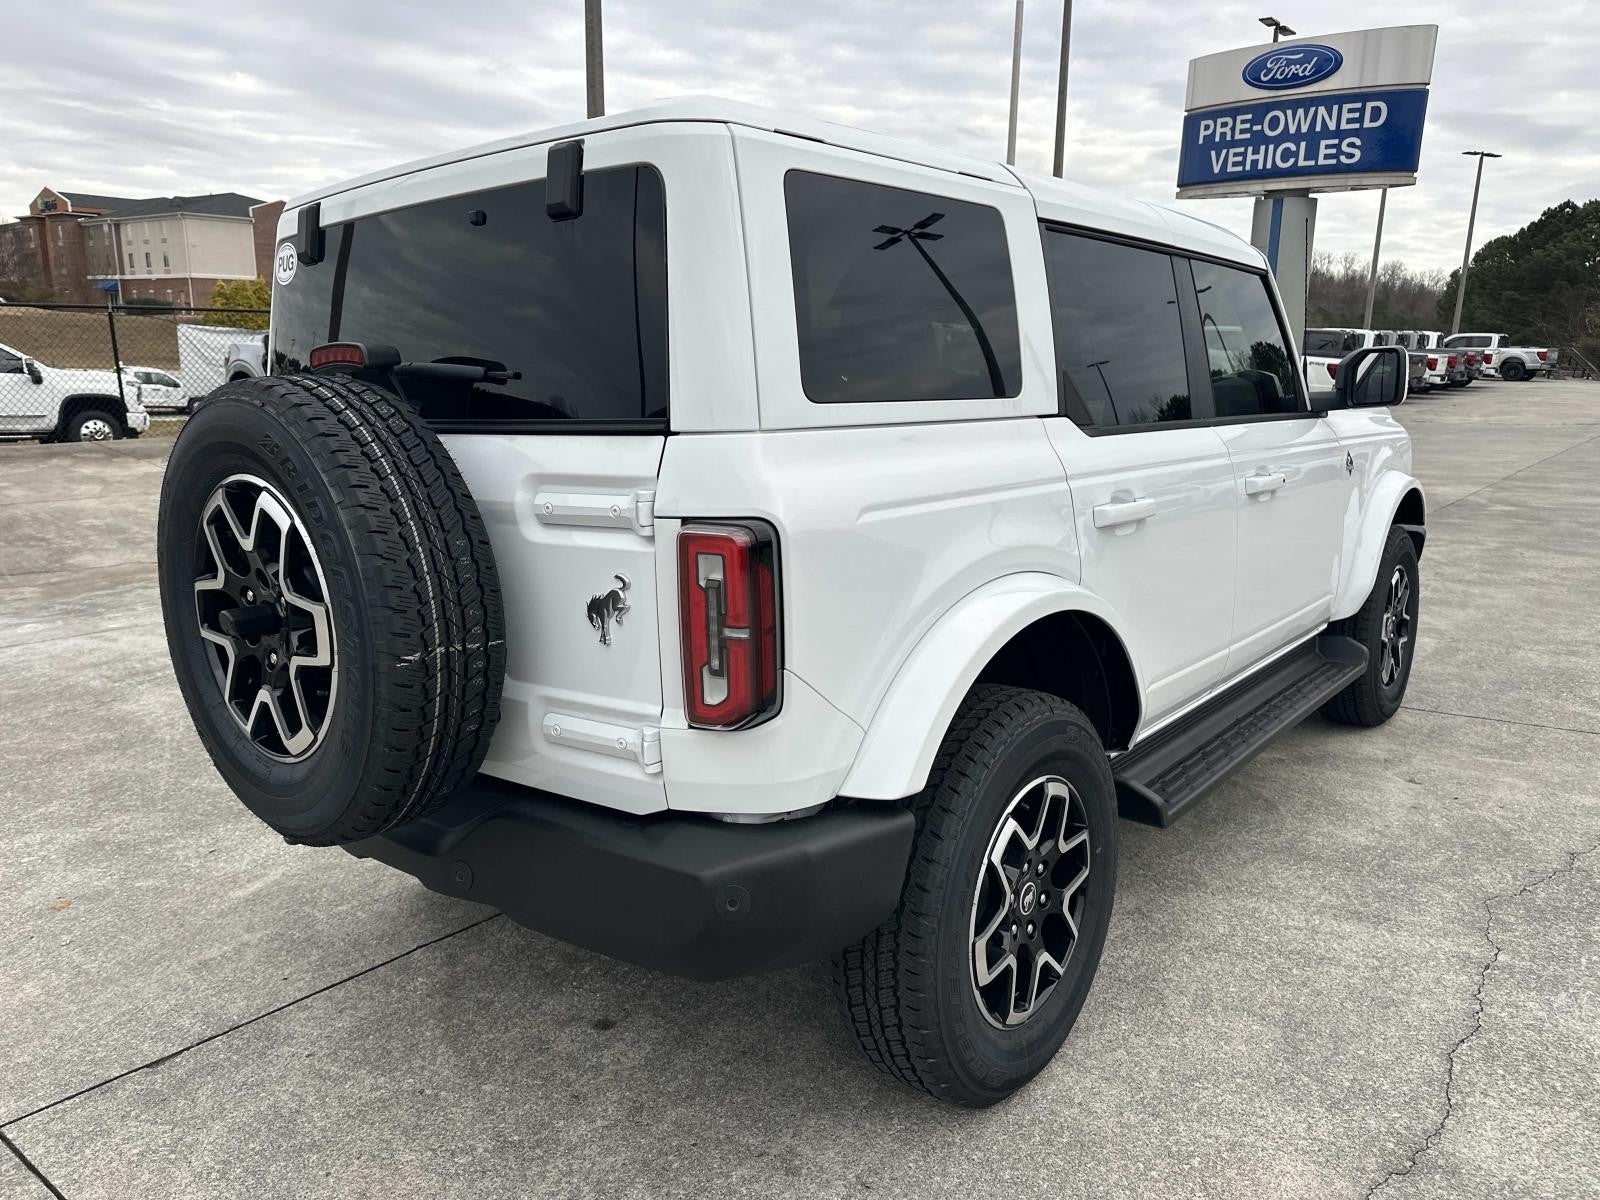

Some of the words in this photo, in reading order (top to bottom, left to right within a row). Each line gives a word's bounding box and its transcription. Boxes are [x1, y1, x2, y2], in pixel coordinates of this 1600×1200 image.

[1261, 53, 1317, 82] Ford
[1199, 101, 1388, 144] PRE-OWNED
[1211, 137, 1362, 174] VEHICLES
[278, 253, 295, 273] PUG
